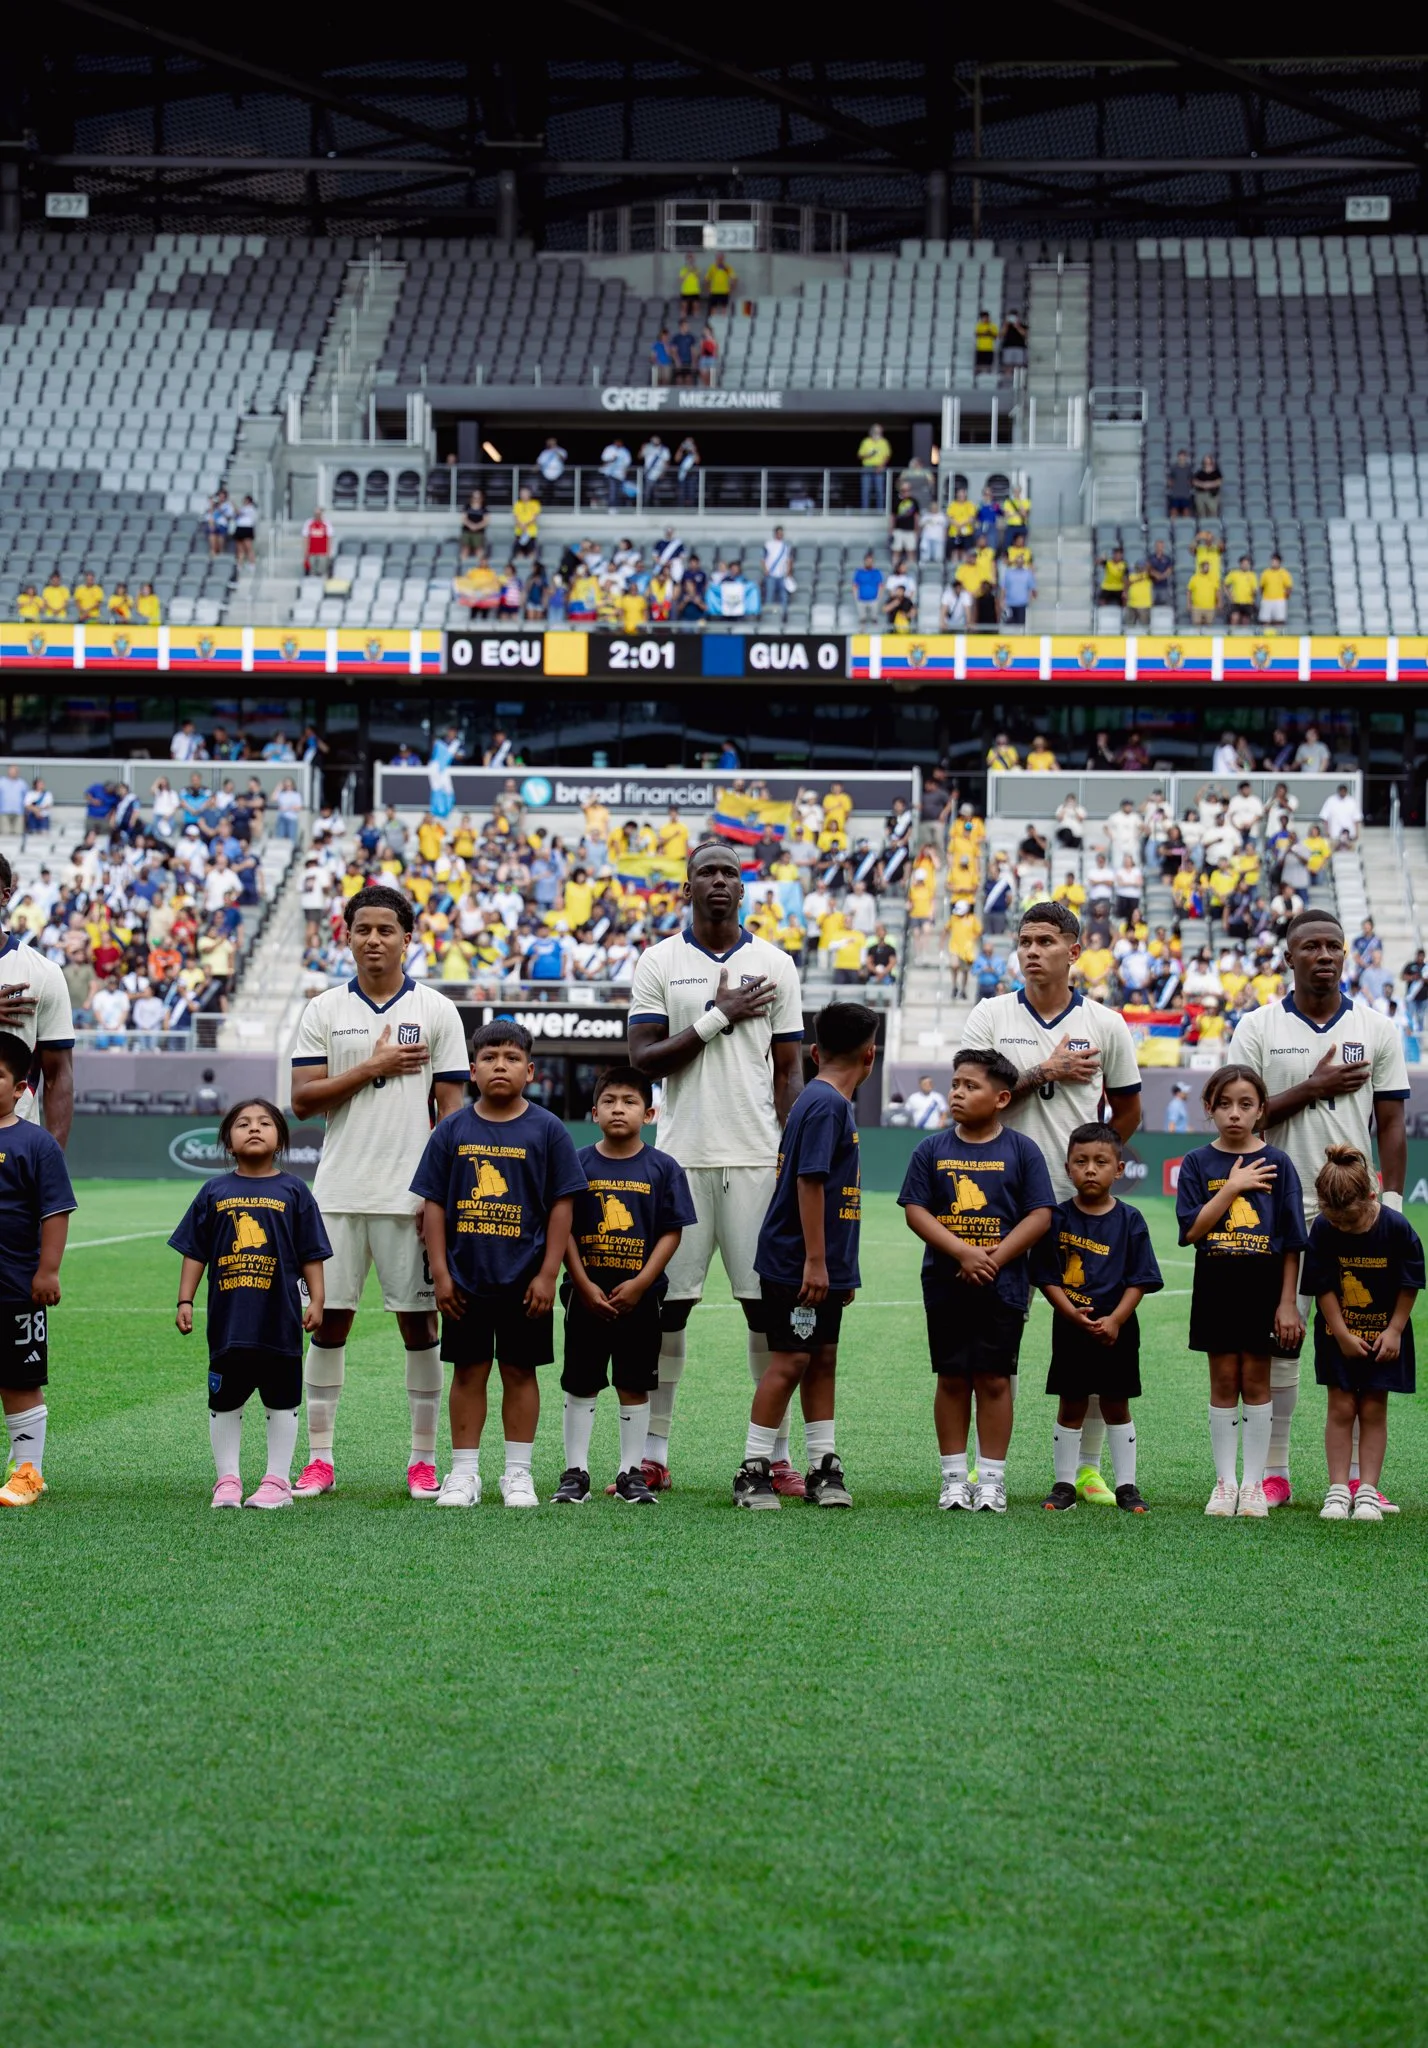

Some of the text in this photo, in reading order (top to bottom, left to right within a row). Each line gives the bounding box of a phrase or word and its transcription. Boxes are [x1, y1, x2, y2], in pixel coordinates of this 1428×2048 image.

[51, 197, 83, 213] 237
[602, 387, 782, 411] GREIF MEZZANINE
[452, 639, 541, 667] 0 ECU
[608, 641, 675, 669] 2:01
[750, 642, 839, 669] GUA 0
[624, 782, 713, 804] financial
[670, 977, 708, 987] marathon
[331, 1028, 369, 1037] marathon
[1270, 1047, 1310, 1055] marathon
[458, 1144, 491, 1153] GUATEMALA
[500, 1147, 526, 1156] ECUADOR
[970, 1160, 977, 1168] VS
[588, 1180, 617, 1188] UATEMALA
[625, 1181, 651, 1190] ECUADOR
[216, 1198, 250, 1209] GUATEMALA
[259, 1198, 286, 1208] ECUADOR
[457, 1200, 522, 1213] SERVIEXPRESS
[581, 1235, 645, 1247] SERVIEXPRESS
[1207, 1233, 1270, 1243] SERVIEXPRES
[218, 1254, 277, 1267] SERVIEXPRESS
[15, 1310, 46, 1345] 38
